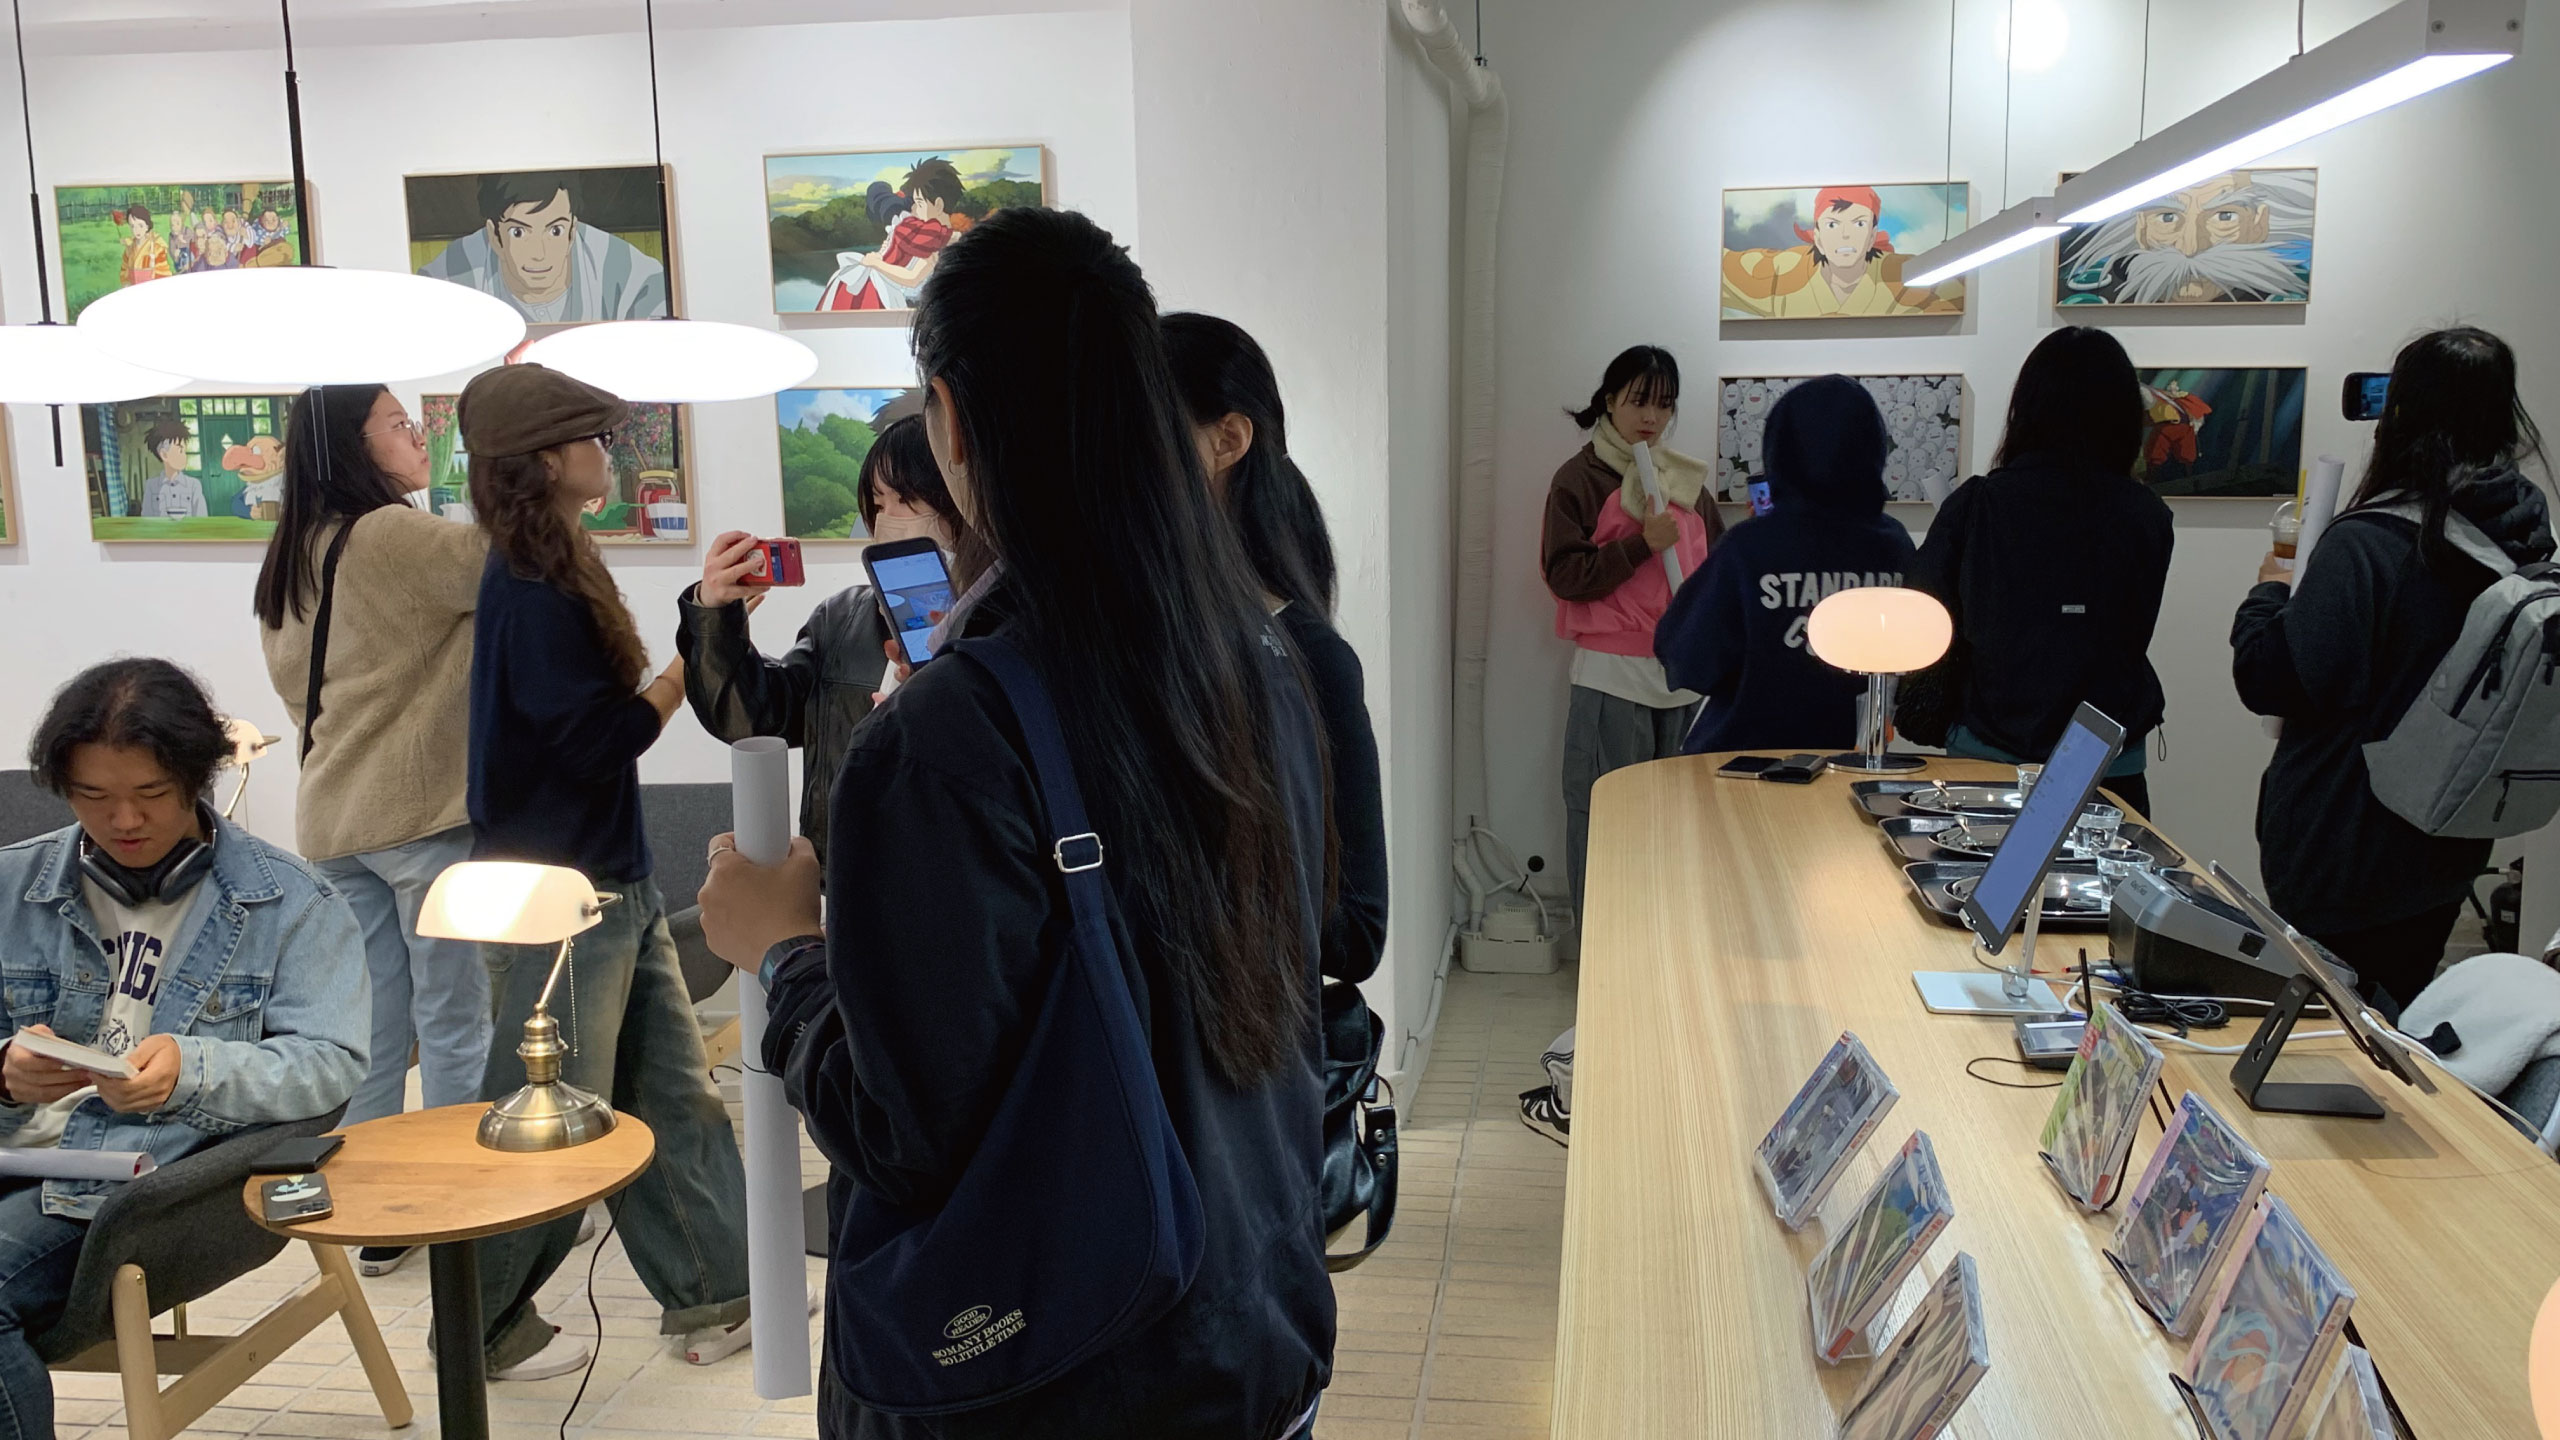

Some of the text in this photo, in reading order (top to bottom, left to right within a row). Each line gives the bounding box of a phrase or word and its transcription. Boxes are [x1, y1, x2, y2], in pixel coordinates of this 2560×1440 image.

[951, 1312, 987, 1337] READER
[953, 1309, 979, 1327] GOOD
[982, 1308, 1023, 1338] BOOKS
